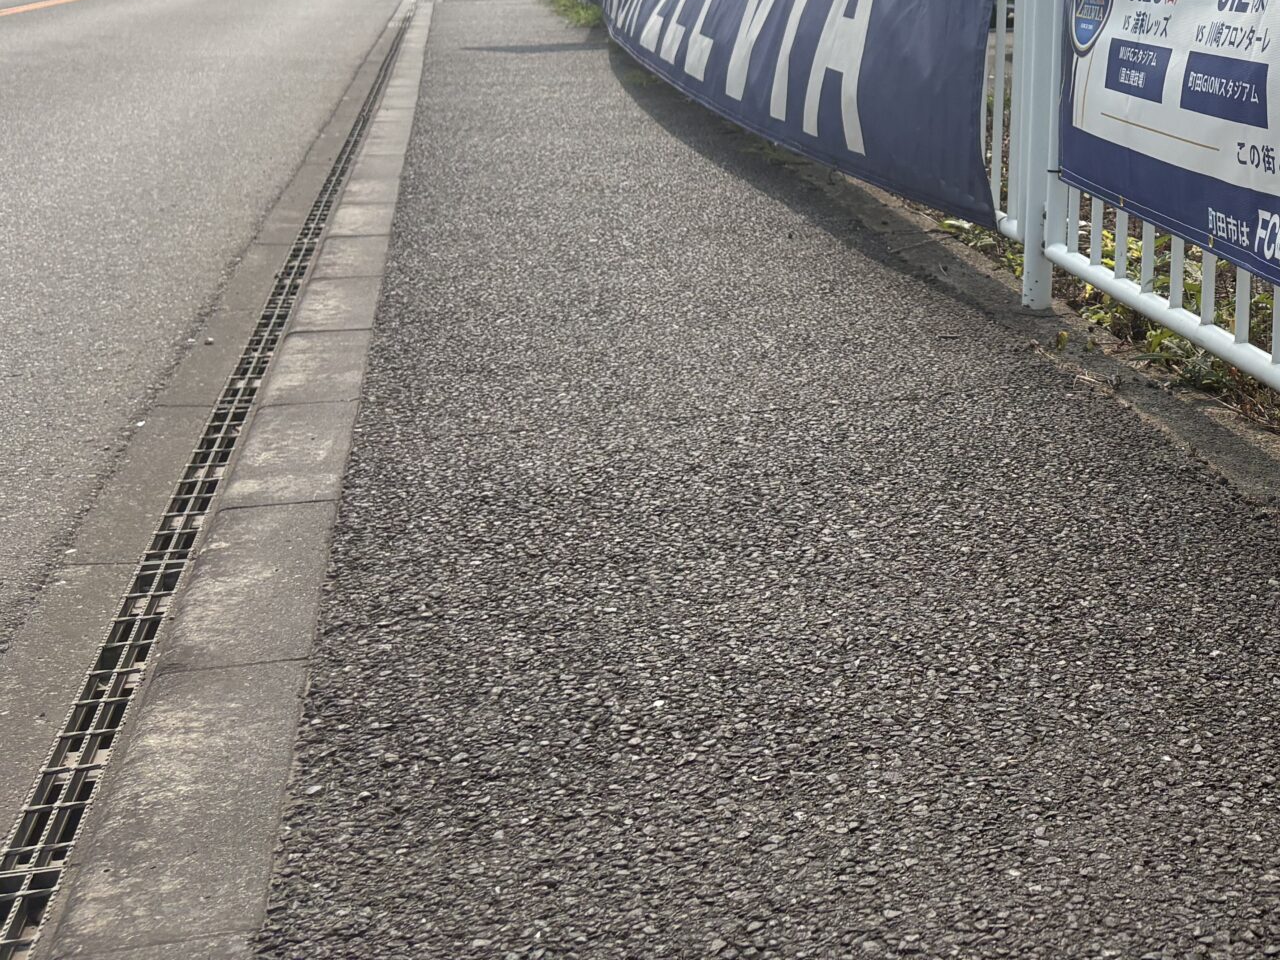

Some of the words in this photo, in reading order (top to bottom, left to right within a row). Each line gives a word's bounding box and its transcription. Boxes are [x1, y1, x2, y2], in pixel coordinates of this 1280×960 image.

[1204, 21, 1271, 53] 川崎フロンターレ
[1118, 46, 1157, 66] MUFGスタジアム
[1188, 71, 1259, 104] 町田GIONスタジアム
[1207, 207, 1249, 247] 町田市は
